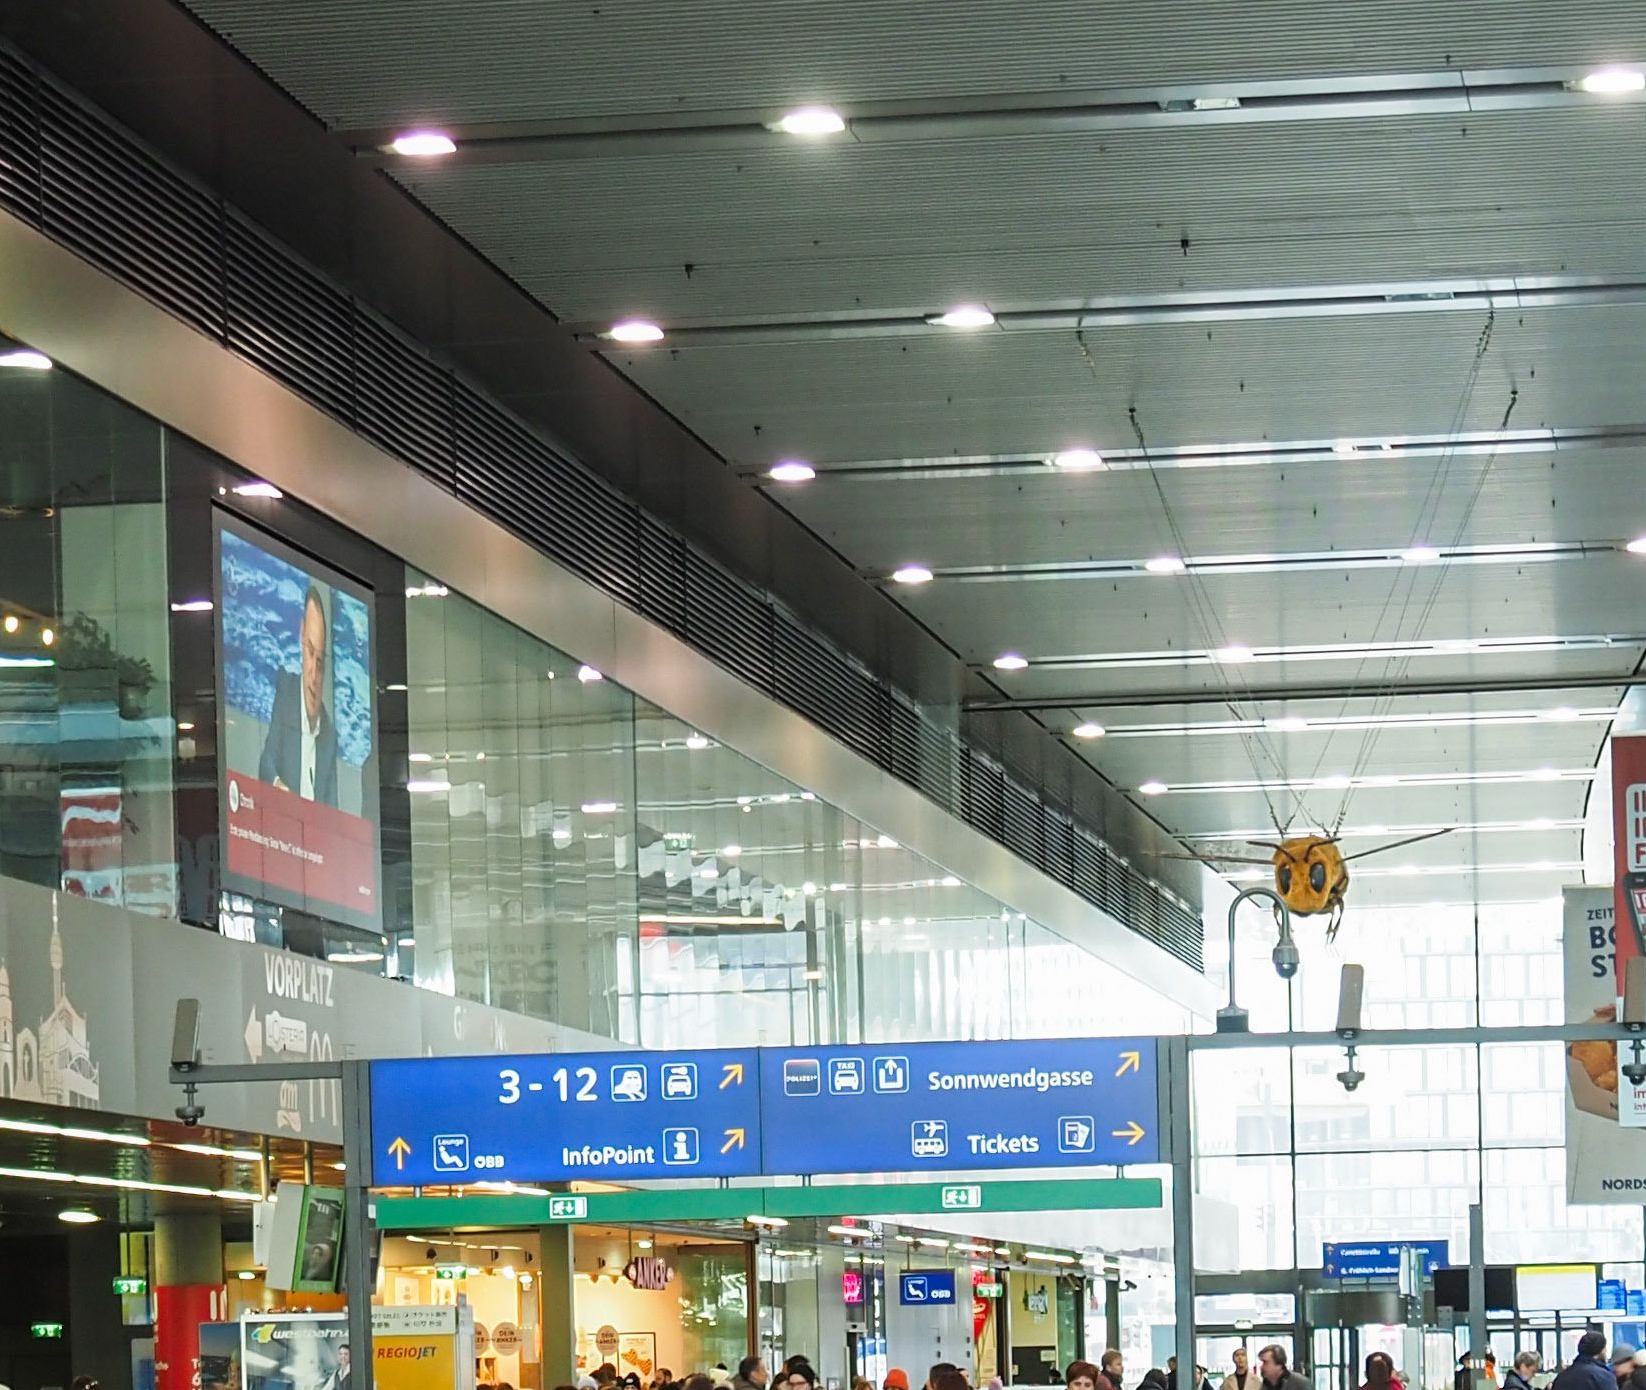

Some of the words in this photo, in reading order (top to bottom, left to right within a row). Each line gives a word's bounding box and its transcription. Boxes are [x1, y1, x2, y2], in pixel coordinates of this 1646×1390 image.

[1587, 907, 1614, 921] ZEIT
[264, 952, 334, 1007] VORPLATZ
[928, 1068, 1093, 1093] Sonnwendgasse
[967, 1133, 1039, 1155] Tickets
[562, 1145, 655, 1167] InfoPoint
[636, 1257, 667, 1290] ANKER
[376, 1346, 437, 1360] REGIOJET
